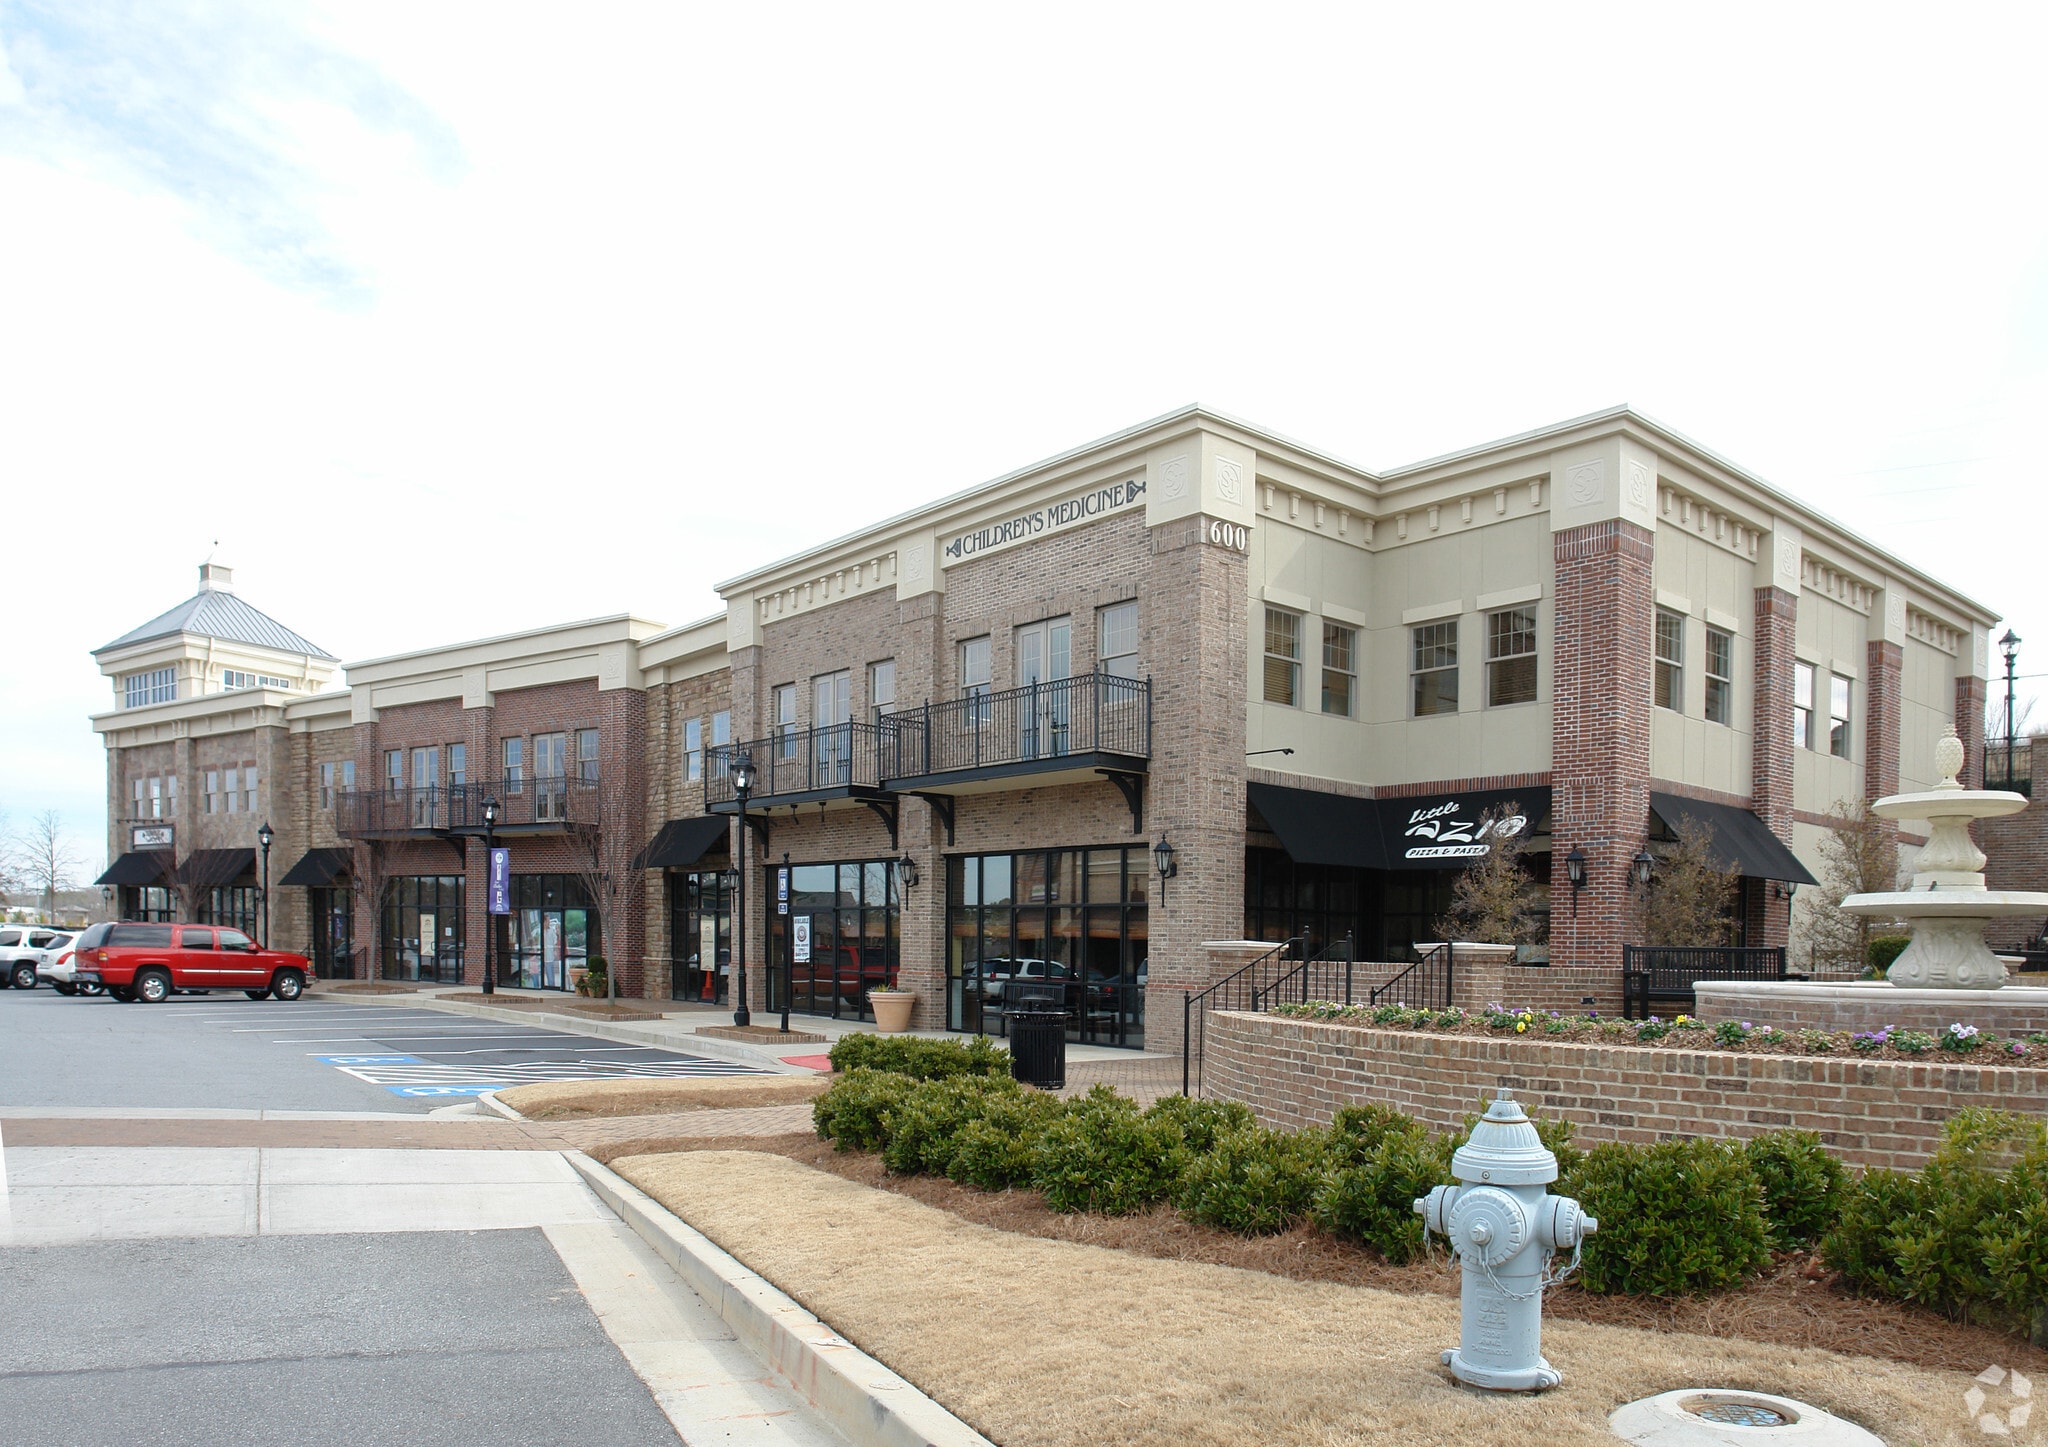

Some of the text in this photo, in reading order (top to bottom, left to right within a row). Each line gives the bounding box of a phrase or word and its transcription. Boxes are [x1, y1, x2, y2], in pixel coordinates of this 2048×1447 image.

[962, 485, 1125, 555] CHILDREN'S MEDICINE
[1209, 520, 1246, 551] 600
[1408, 801, 1460, 824] Little
[1409, 846, 1487, 857] PIZZA & PASTA
